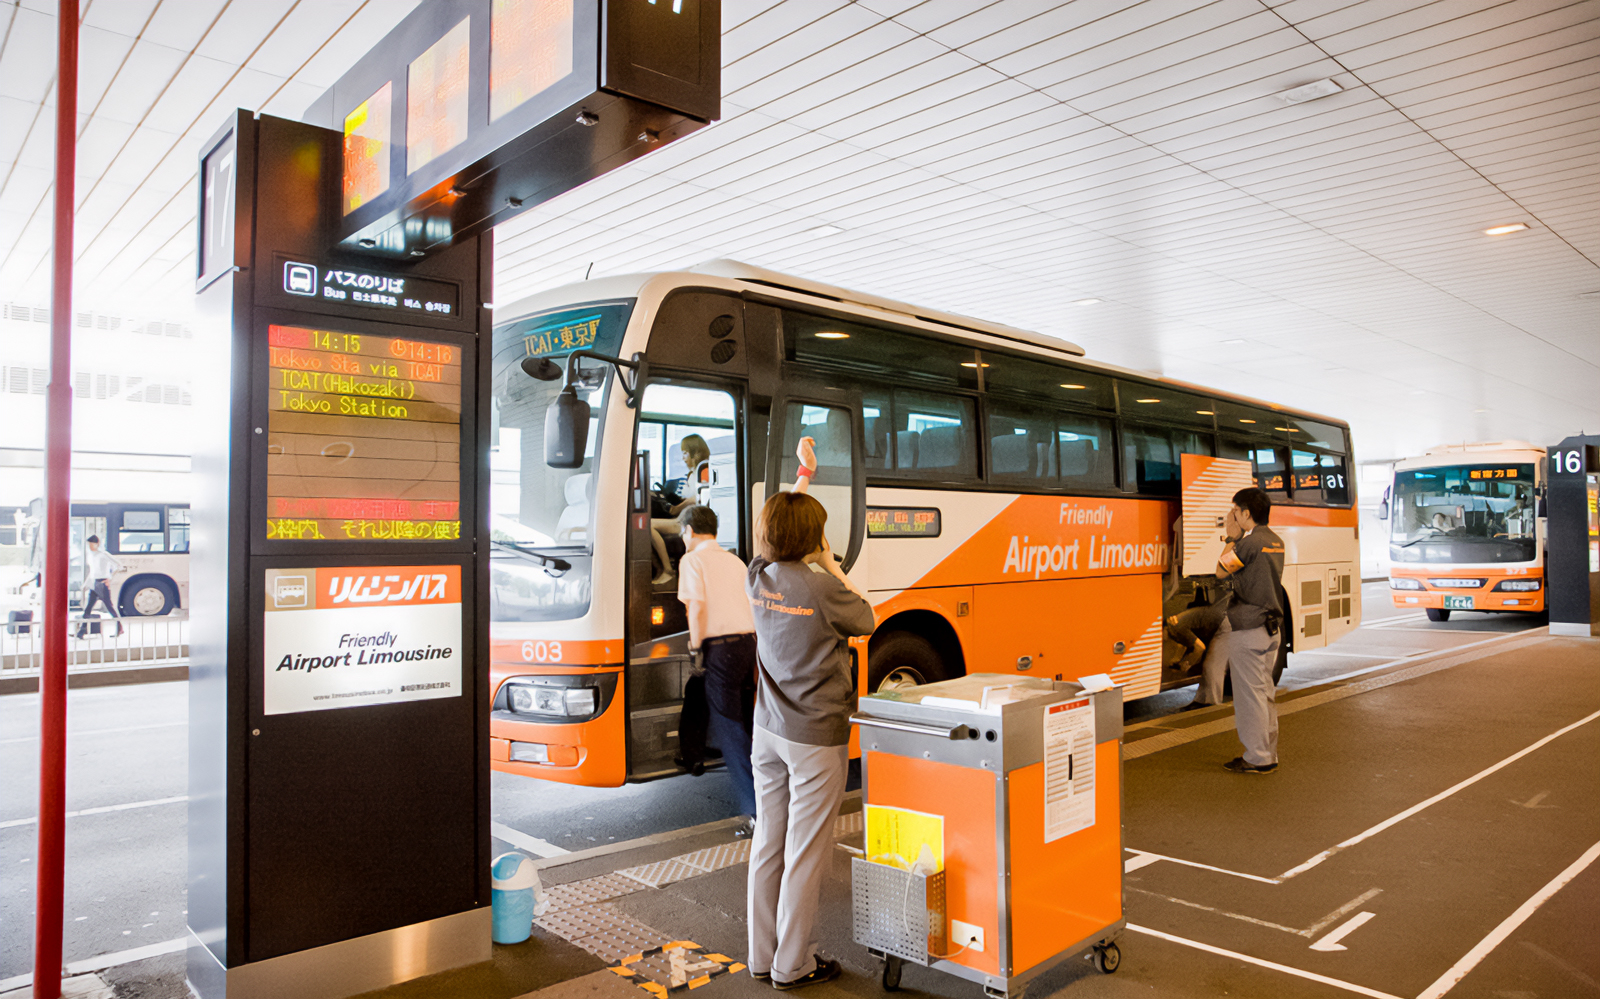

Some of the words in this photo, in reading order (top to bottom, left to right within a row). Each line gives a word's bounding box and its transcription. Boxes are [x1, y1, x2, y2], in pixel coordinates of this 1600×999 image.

[206, 149, 234, 257] 17
[323, 286, 347, 299] Bus
[324, 270, 405, 294] バスのりば
[313, 331, 361, 353] 14:15
[272, 347, 322, 369] Tokyo
[330, 354, 361, 374] Sta
[369, 361, 398, 377] via
[408, 362, 444, 381] TCAT
[280, 369, 415, 399] TCAT(Hakozaki)
[279, 391, 331, 413] Tokyo
[340, 395, 408, 418] Station
[1552, 450, 1581, 474] 16
[1059, 503, 1113, 529] Friendly
[1003, 535, 1080, 579] Airport
[329, 574, 448, 603] リムジンバス
[338, 631, 398, 648] Friendly
[521, 641, 562, 662] 603
[276, 651, 351, 673] Airport
[357, 644, 453, 666] Limousine
